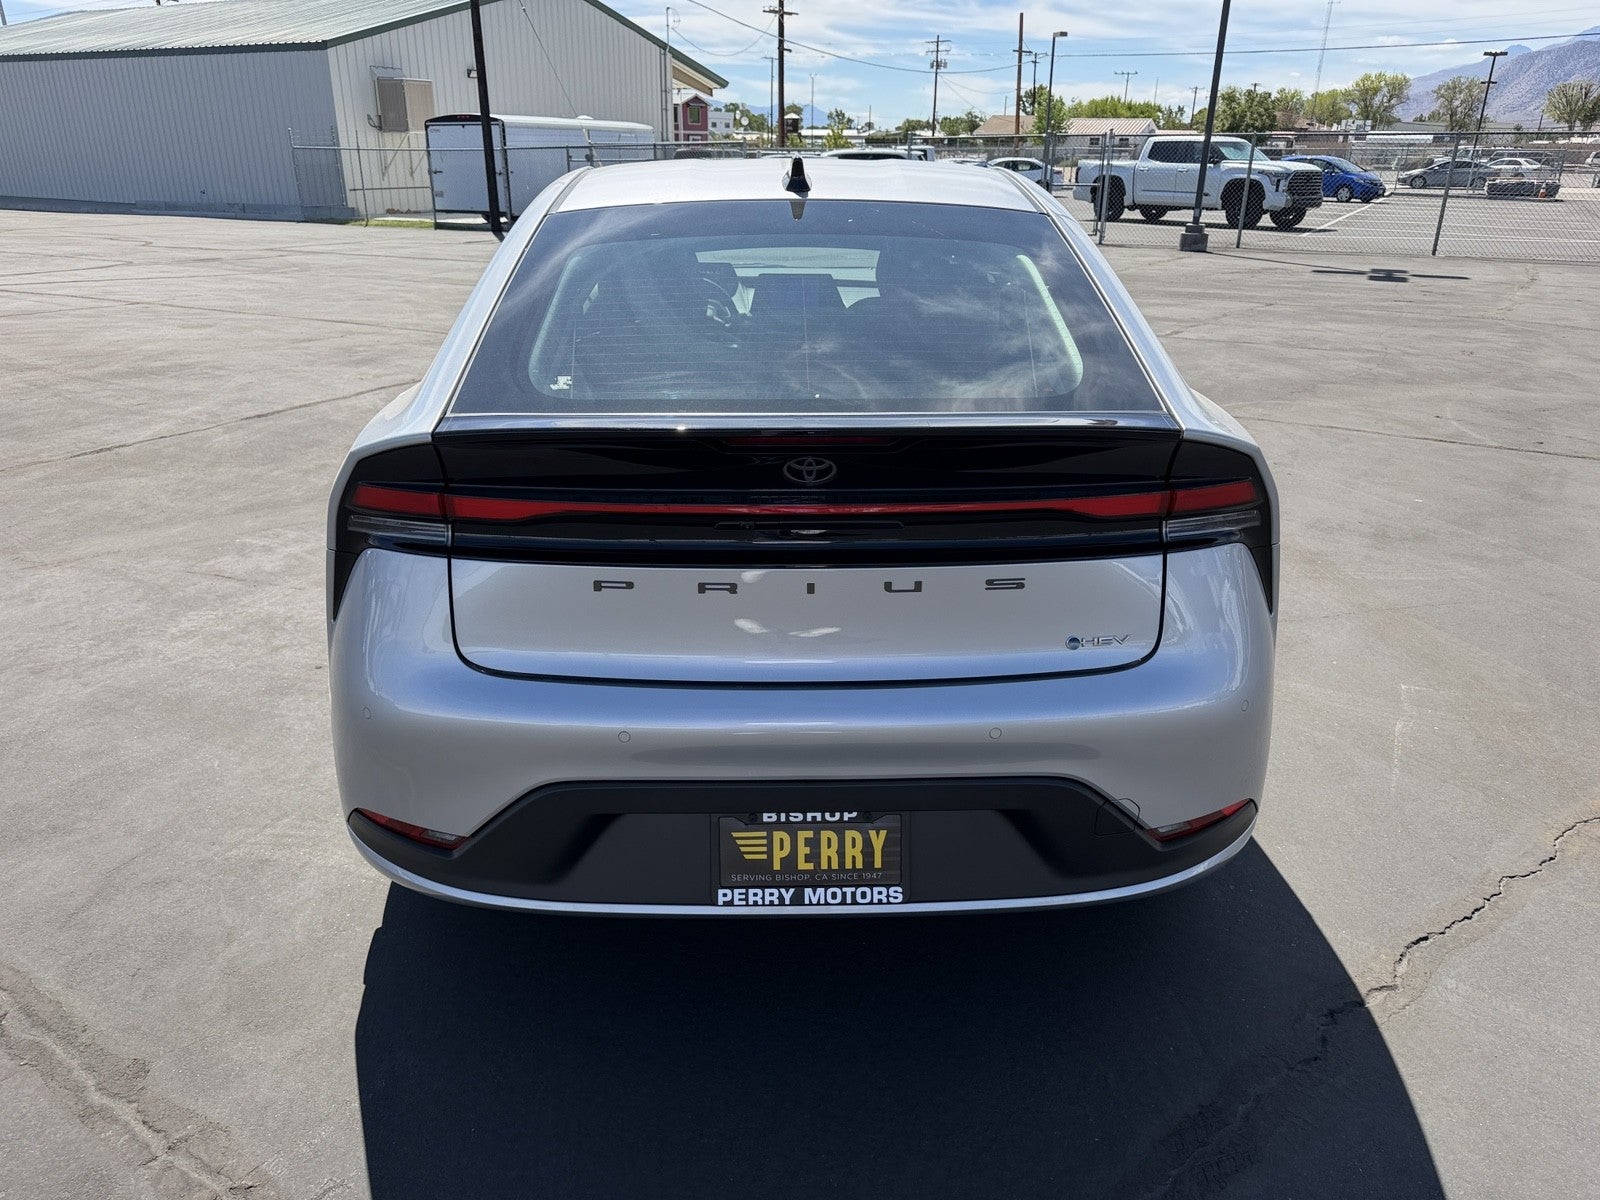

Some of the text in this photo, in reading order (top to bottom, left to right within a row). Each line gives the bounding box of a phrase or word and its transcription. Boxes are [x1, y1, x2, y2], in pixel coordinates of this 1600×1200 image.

[593, 578, 1026, 595] PRIUS
[1081, 634, 1131, 647] HEV
[762, 811, 858, 822] BISHOP
[772, 829, 888, 871] PERRY
[731, 873, 772, 882] SERVING
[814, 873, 828, 881] CA
[831, 873, 859, 881] SINCE
[862, 872, 882, 880] 1947
[717, 886, 904, 906] PERRY MOTORS
